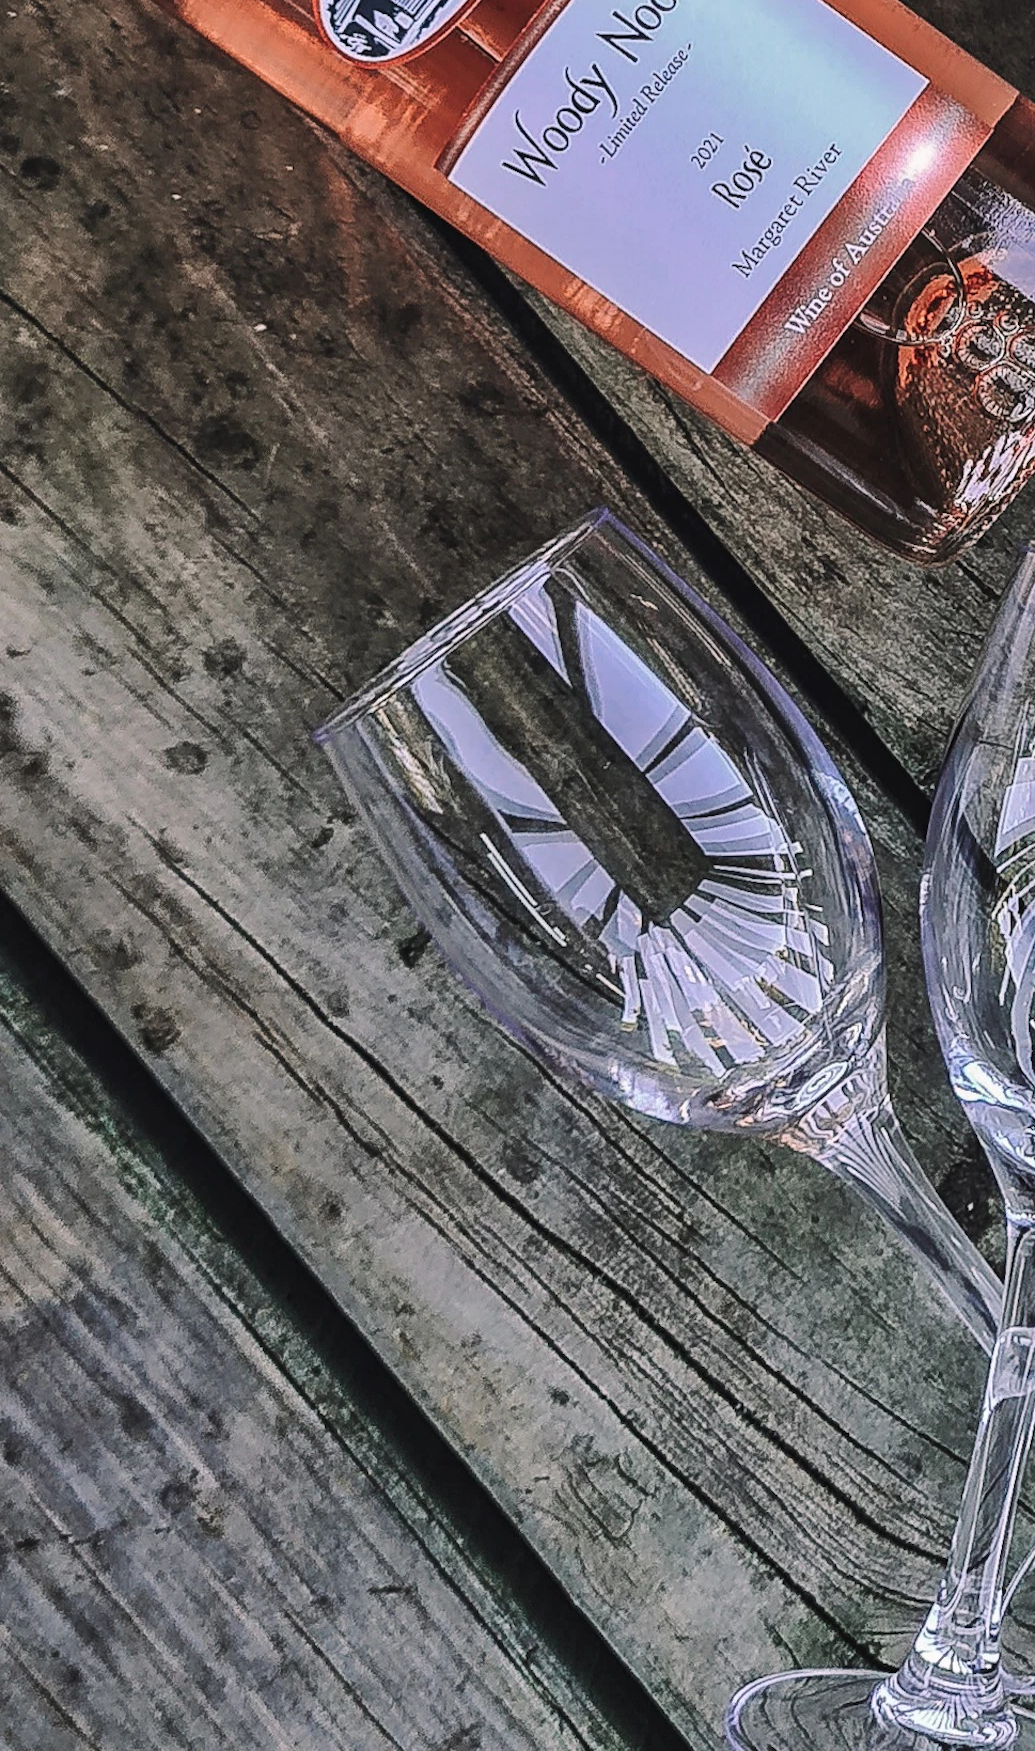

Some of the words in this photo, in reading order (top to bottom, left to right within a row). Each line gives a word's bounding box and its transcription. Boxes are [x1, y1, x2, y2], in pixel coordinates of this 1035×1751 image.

[502, 63, 618, 187] Woody
[599, 98, 648, 158] Limited
[640, 50, 689, 103] Release
[691, 132, 724, 169] 2021
[711, 145, 772, 209] Rosé
[732, 196, 804, 278] Margaret
[793, 144, 842, 196] River
[785, 287, 832, 335] Wine
[830, 258, 851, 287] of
